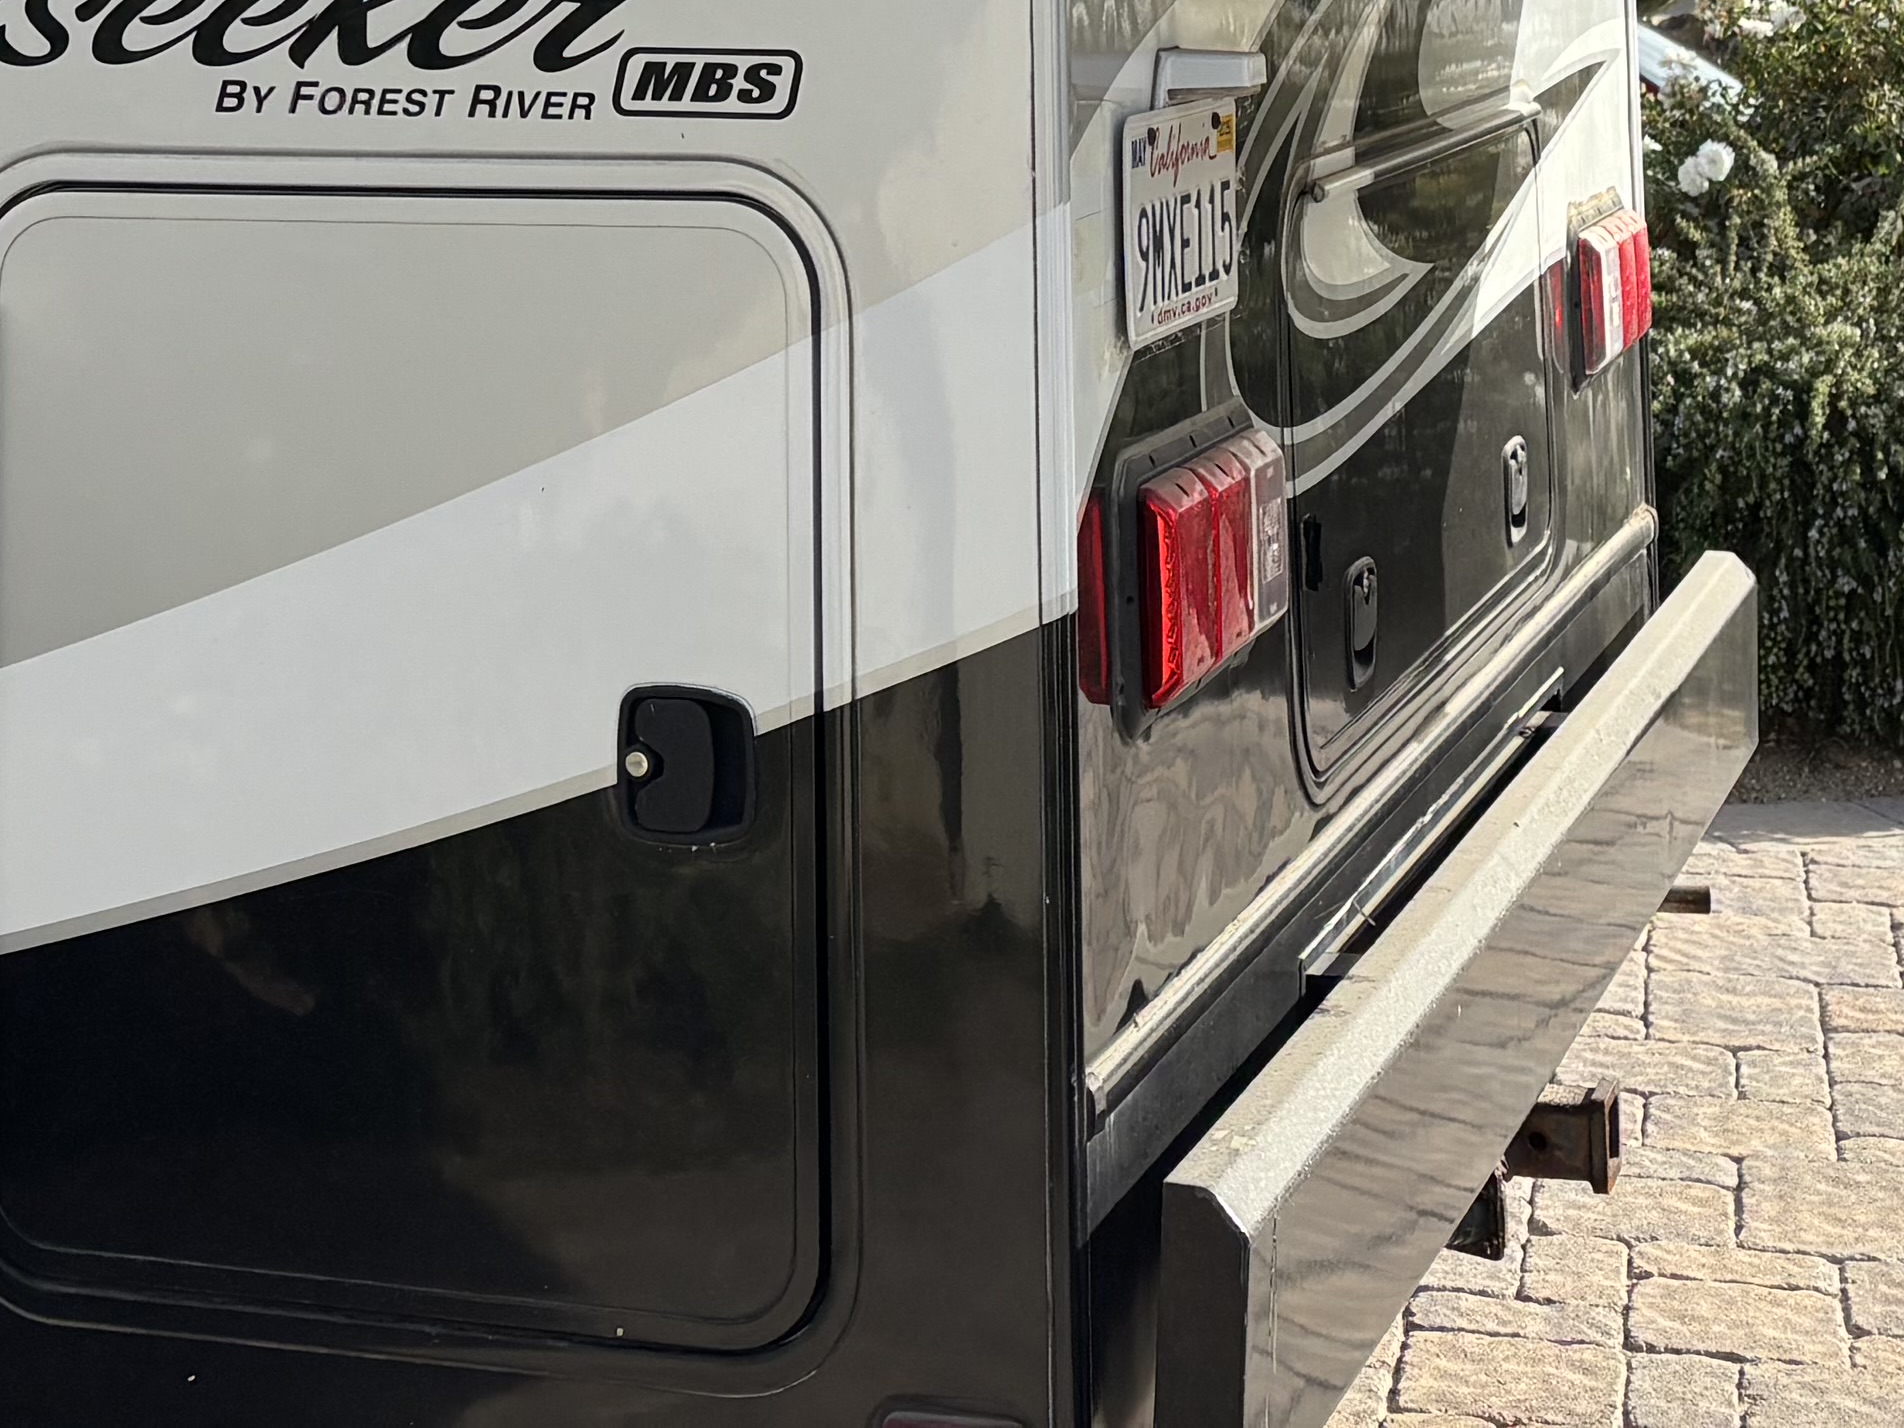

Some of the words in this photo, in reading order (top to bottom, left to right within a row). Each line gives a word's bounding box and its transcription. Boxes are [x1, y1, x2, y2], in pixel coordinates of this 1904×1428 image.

[215, 79, 276, 114] BY
[288, 80, 456, 117] FOREST
[467, 84, 596, 121] RIVER
[631, 61, 783, 105] MBS
[1131, 137, 1147, 169] MAY
[1149, 123, 1217, 187] California
[1137, 180, 1233, 314] 9MXE115
[1157, 291, 1214, 325] dmv.ca.gov
